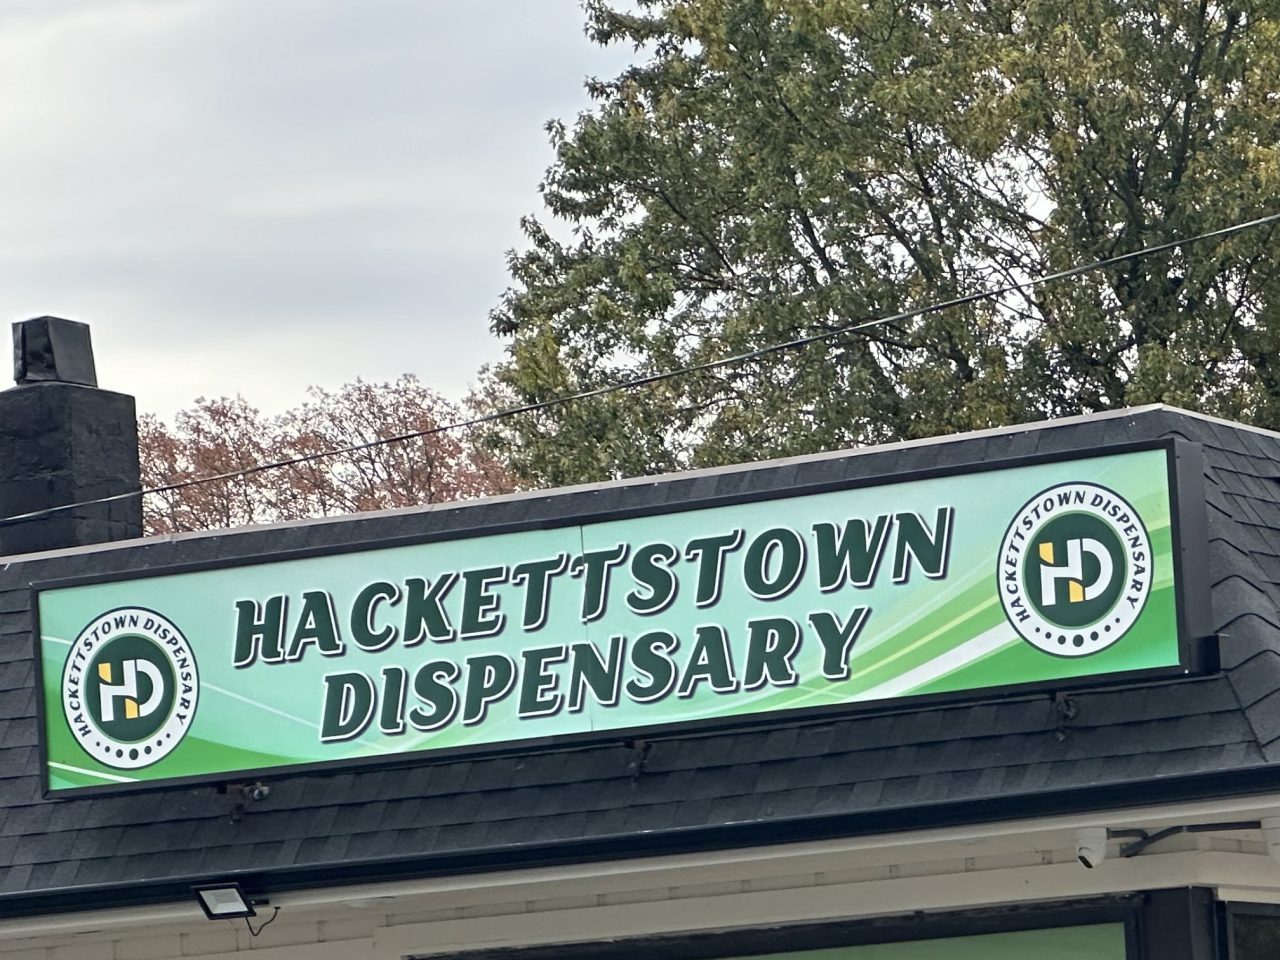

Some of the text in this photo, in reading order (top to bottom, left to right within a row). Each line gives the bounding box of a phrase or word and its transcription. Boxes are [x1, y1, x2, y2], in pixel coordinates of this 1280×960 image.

[232, 506, 955, 667] HACKETTSTOWN
[1005, 491, 1145, 623] HACKETTSTOWN DISPENSARY
[1039, 538, 1113, 606] HD
[68, 615, 193, 737] HACKETTSTOWN DISPENSARY
[98, 659, 164, 722] HD
[319, 606, 872, 743] DISPENSARY
